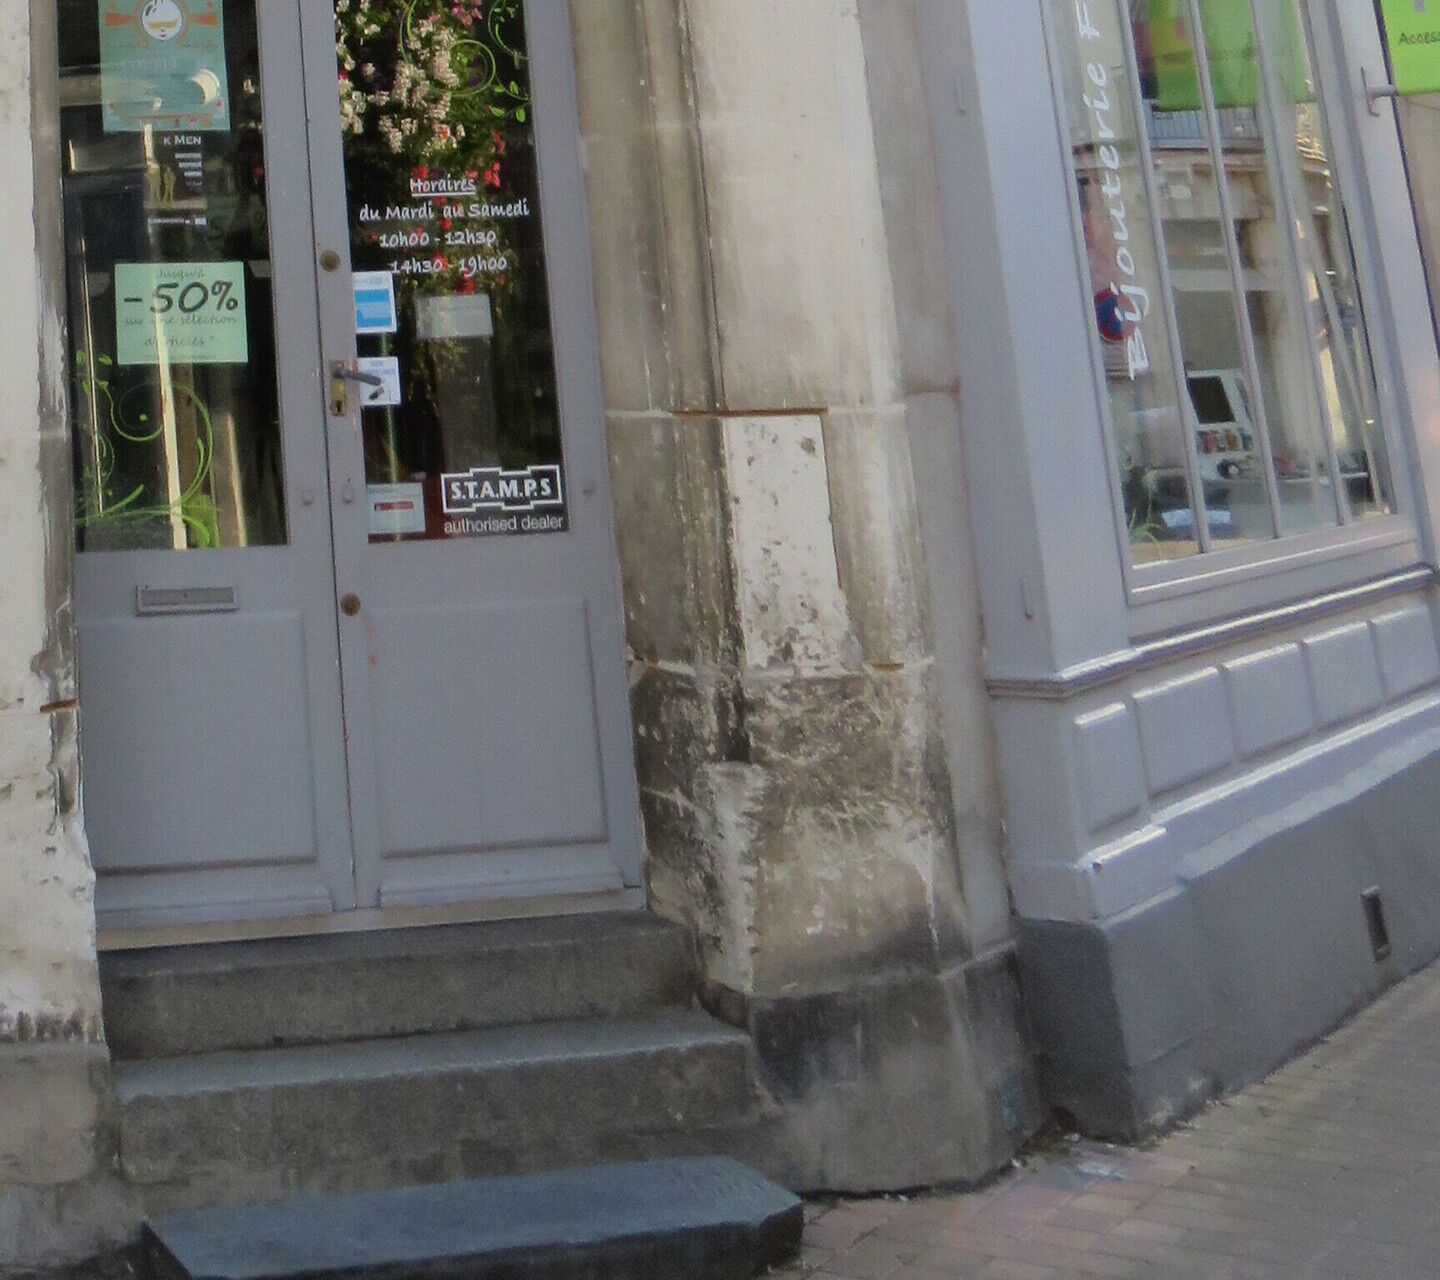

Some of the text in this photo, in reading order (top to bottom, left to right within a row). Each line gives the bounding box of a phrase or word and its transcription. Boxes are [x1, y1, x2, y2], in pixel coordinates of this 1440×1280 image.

[1398, 31, 1440, 45] Acces
[410, 173, 477, 193] Horaires
[360, 197, 530, 221] du Mardi au Samedi
[1081, 61, 1150, 381] Bijouterie
[380, 230, 430, 248] 10h00
[445, 229, 496, 246] 12h30
[390, 258, 443, 274] 14h30
[459, 255, 508, 278] 19h00
[124, 280, 238, 314] -50%
[444, 514, 564, 535] authorised dealer
